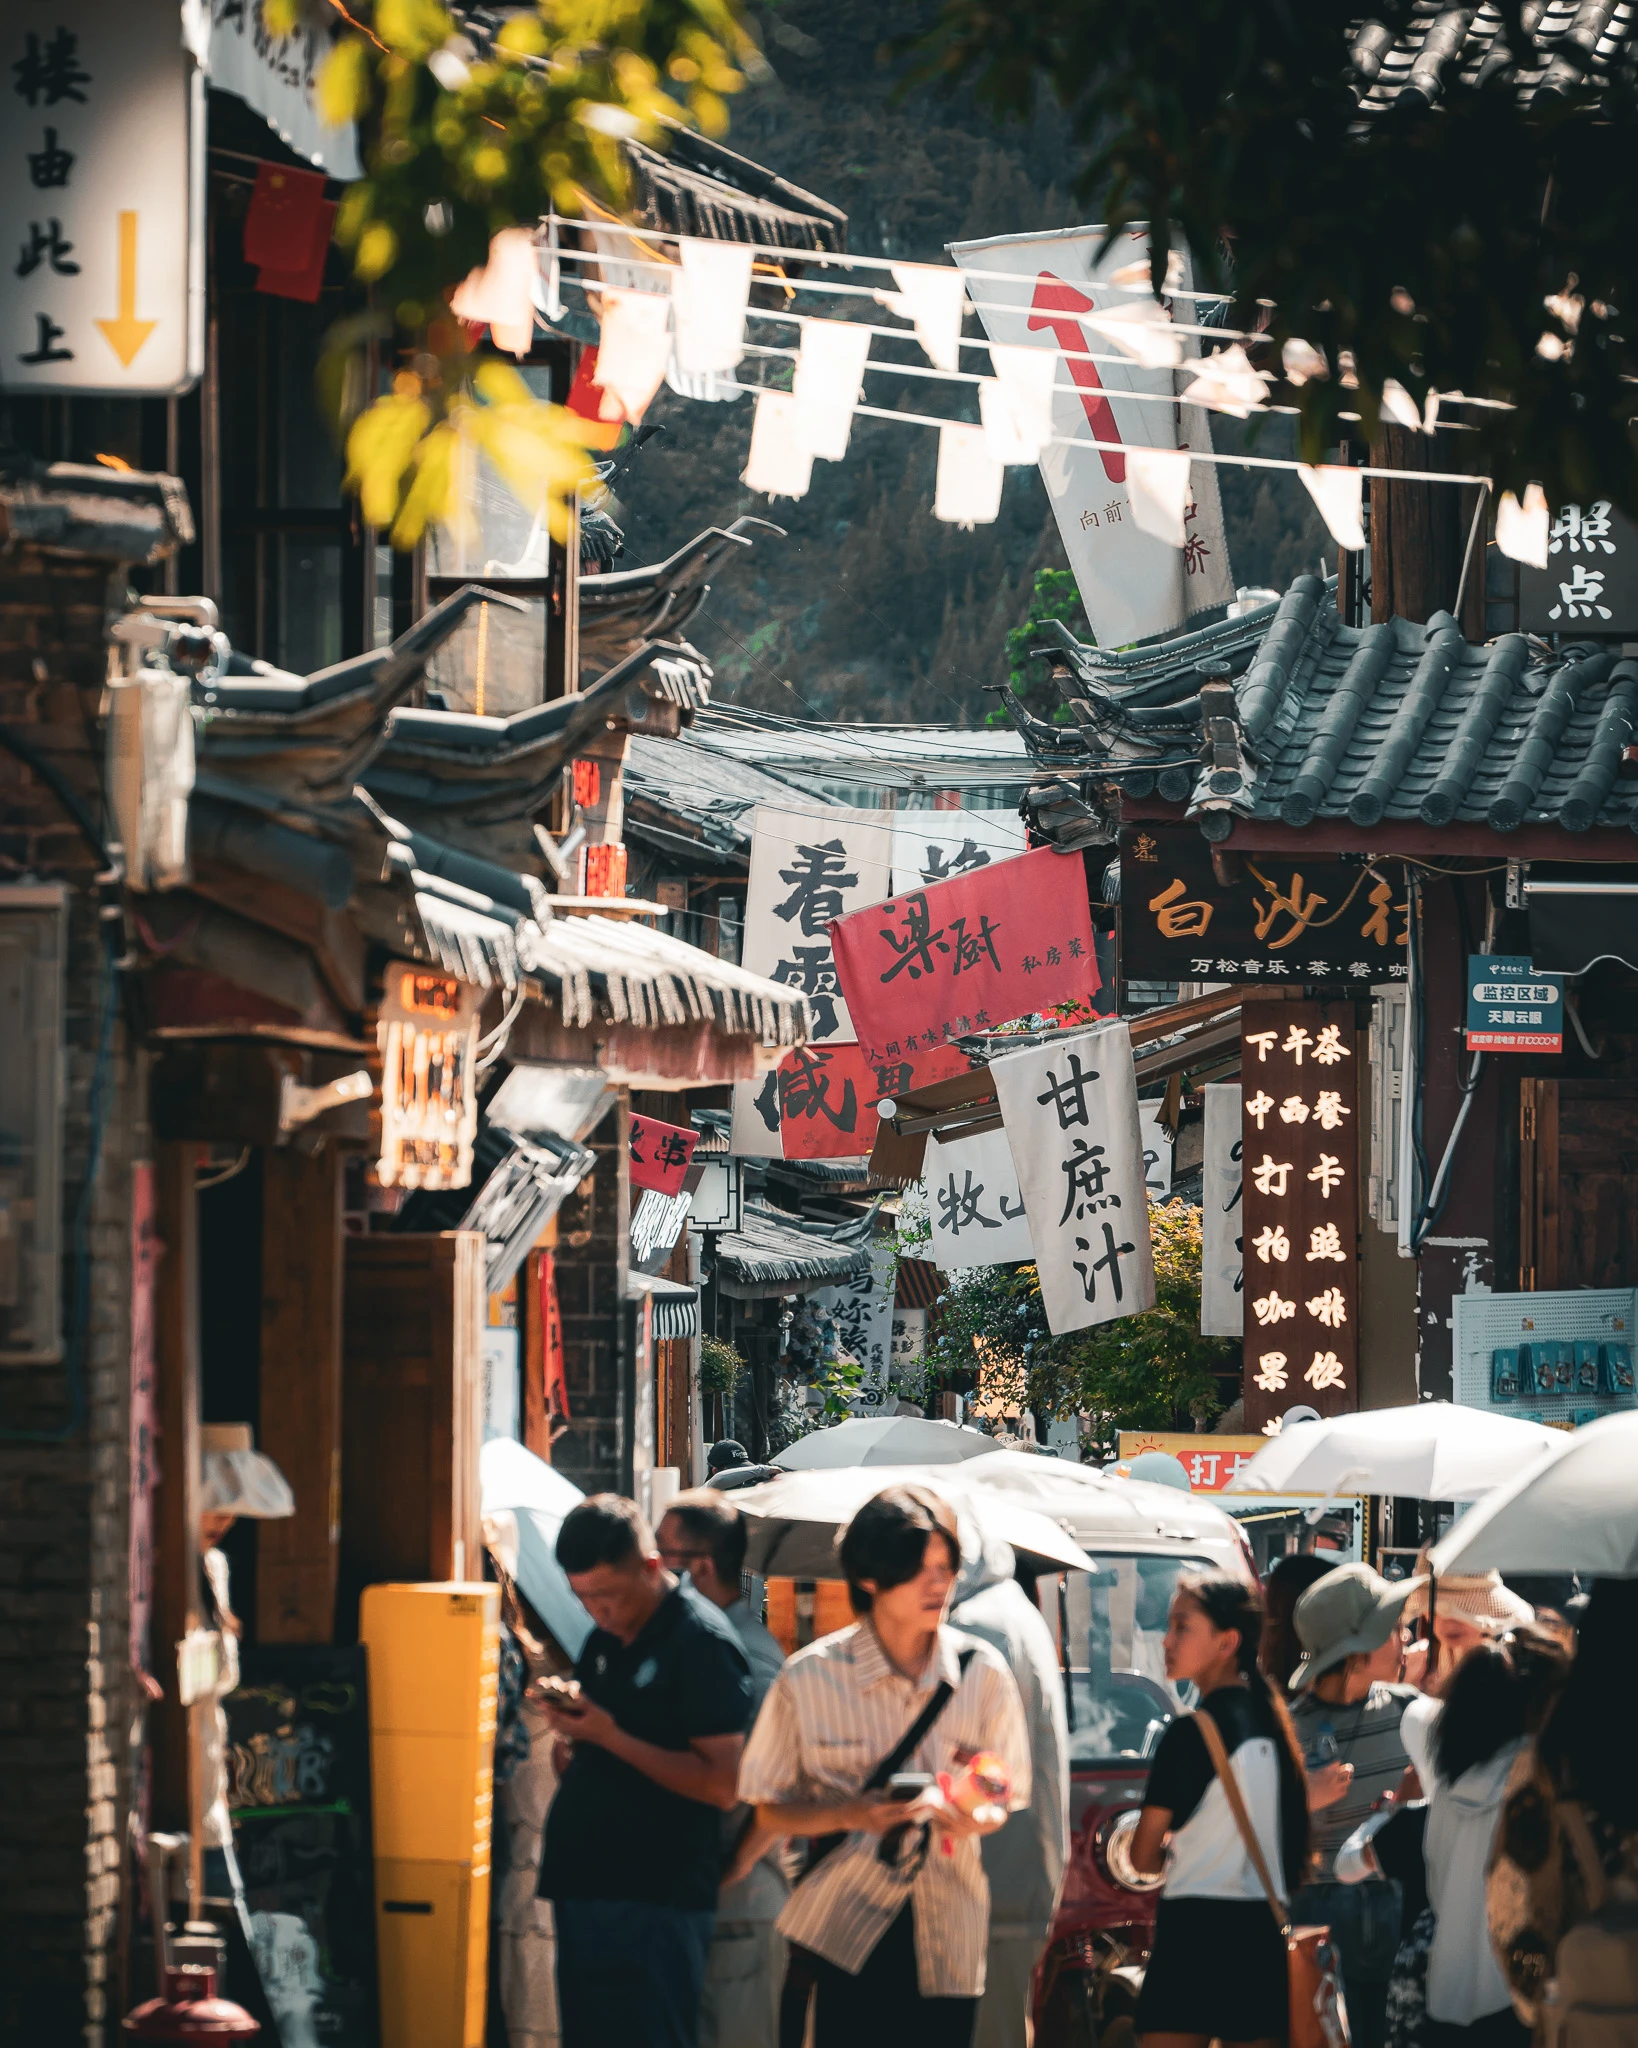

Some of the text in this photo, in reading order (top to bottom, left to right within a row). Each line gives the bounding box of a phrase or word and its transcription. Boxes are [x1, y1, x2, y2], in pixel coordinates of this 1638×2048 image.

[10, 26, 92, 366] 楼由此上
[1080, 499, 1130, 531] 向前
[1021, 937, 1086, 975] 私房菜
[1483, 986, 1549, 1002] 监控区域
[1488, 1010, 1542, 1025] 天翼云眼
[1245, 1024, 1351, 1066] 下午茶
[1245, 1090, 1351, 1130] 中西餐
[1252, 1154, 1346, 1199] 打卡
[1252, 1222, 1347, 1264] 拍照
[1252, 1286, 1347, 1328] 咖啡
[1252, 1351, 1346, 1392] 果饮
